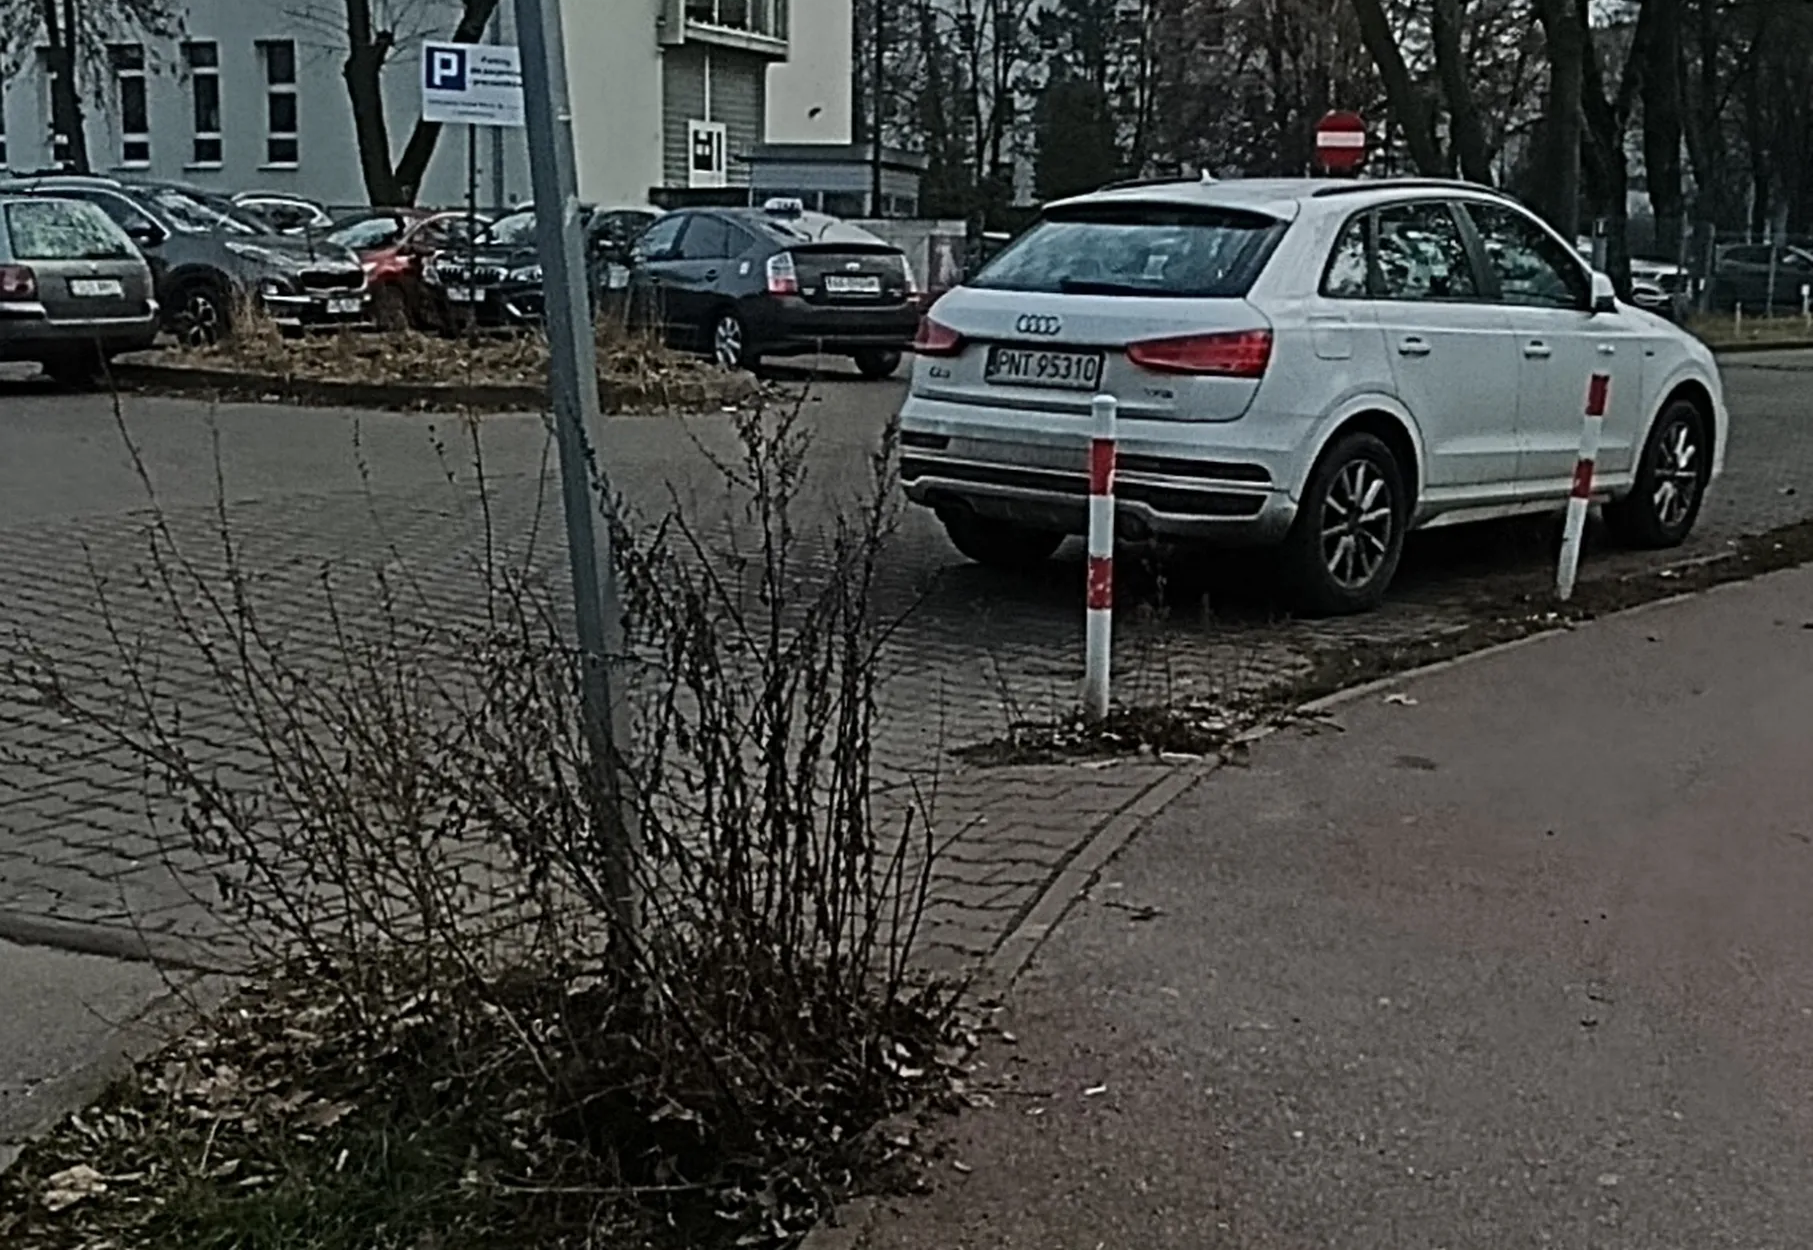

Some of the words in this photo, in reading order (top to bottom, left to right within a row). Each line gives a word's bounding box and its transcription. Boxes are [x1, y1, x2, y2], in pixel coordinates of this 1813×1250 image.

[433, 51, 458, 86] P
[999, 352, 1033, 377] PNT
[1037, 354, 1096, 382] 95310
